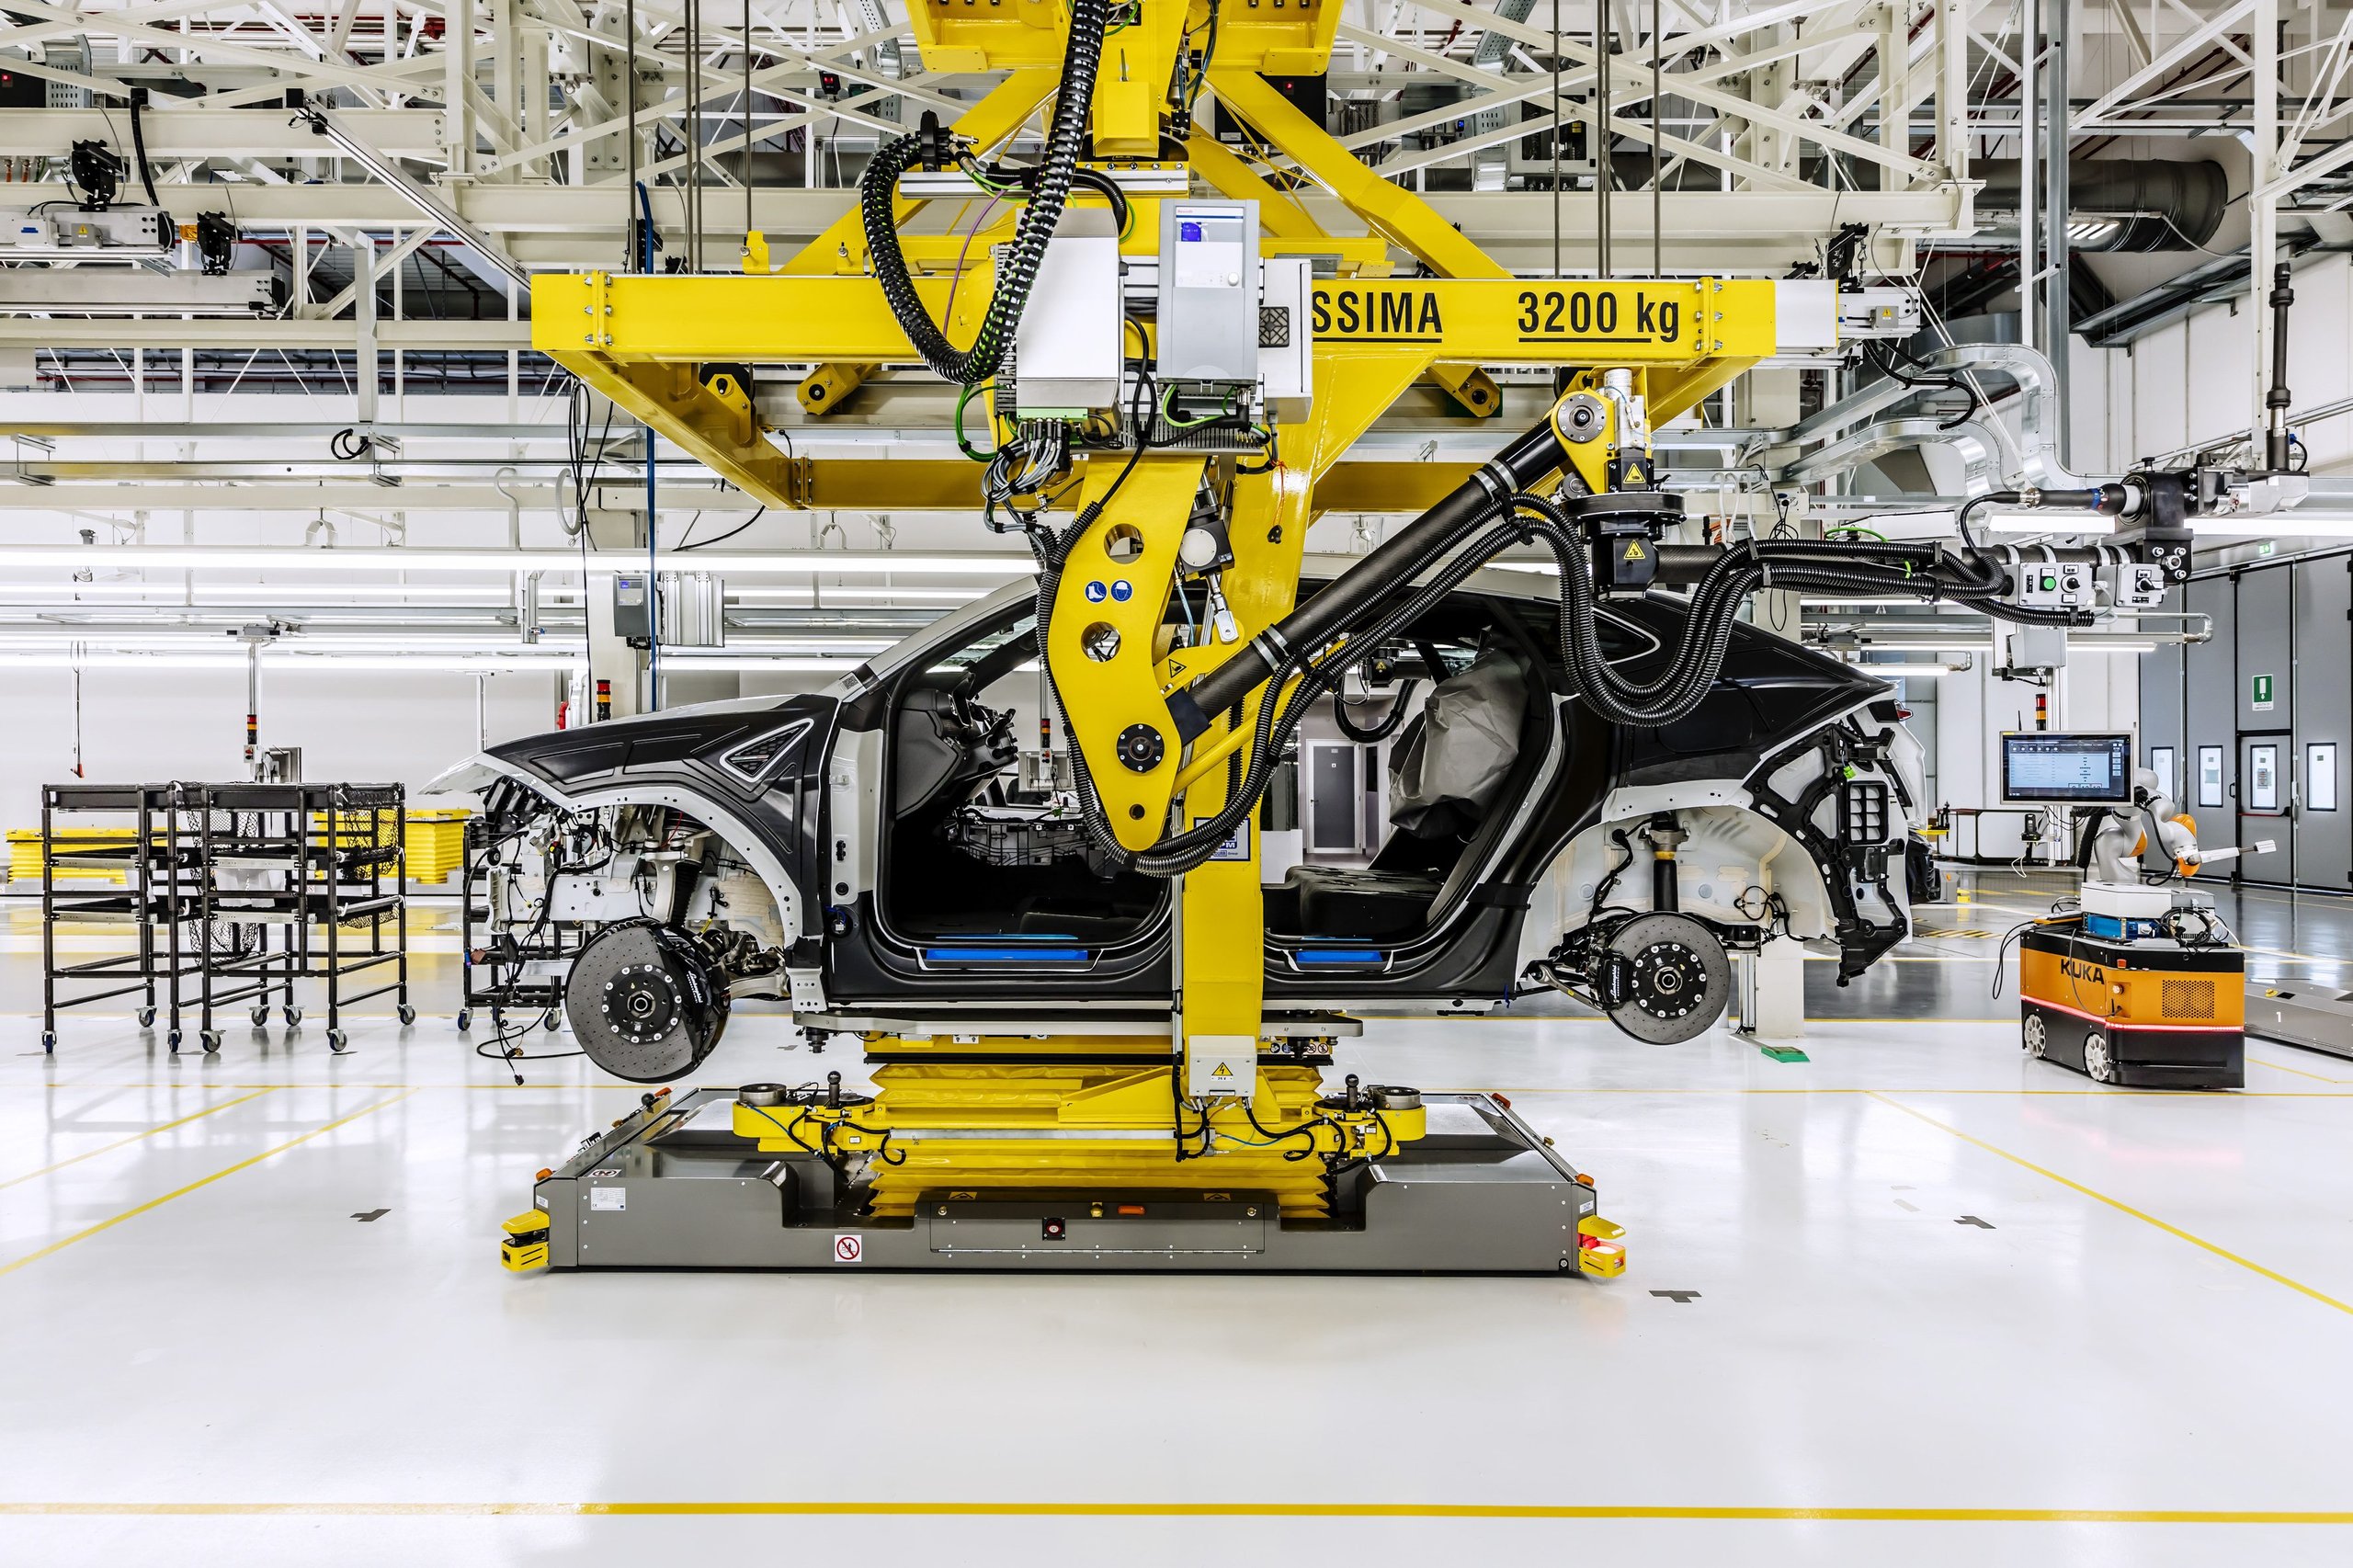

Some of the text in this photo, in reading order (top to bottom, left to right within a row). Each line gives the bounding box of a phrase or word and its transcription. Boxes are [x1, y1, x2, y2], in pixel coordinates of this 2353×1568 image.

[1313, 290, 1679, 342] SSIMA 3200 kg
[2061, 959, 2105, 985] KUKA
[2276, 1011, 2281, 1023] 1
